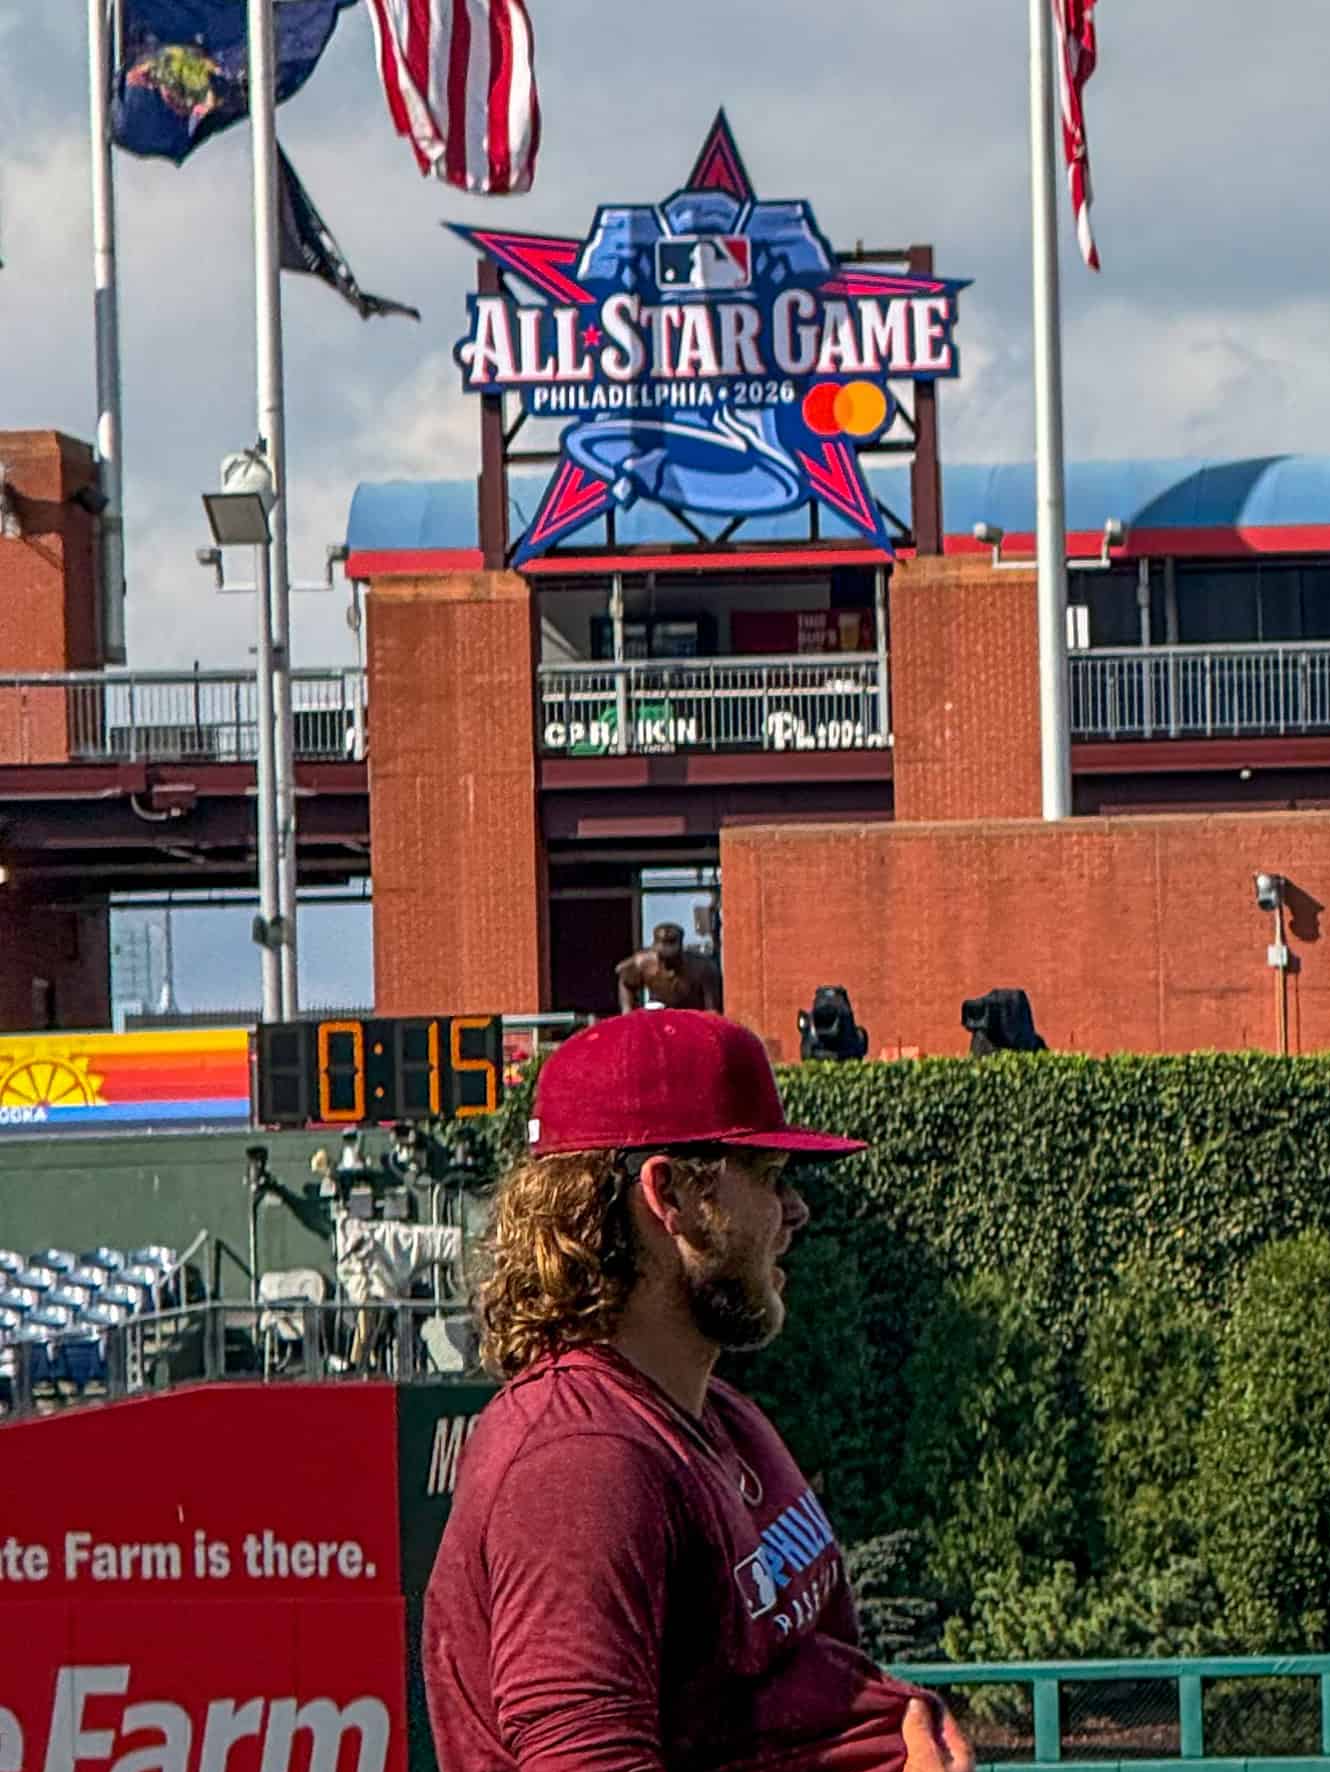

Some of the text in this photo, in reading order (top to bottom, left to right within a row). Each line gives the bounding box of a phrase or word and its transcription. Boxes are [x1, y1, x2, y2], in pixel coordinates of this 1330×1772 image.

[461, 289, 952, 384] ALL STAR GAME
[534, 381, 795, 411] PHILADELPHIA 2026
[317, 1018, 497, 1121] 0:15
[0, 1529, 377, 1581] te Farm is there.
